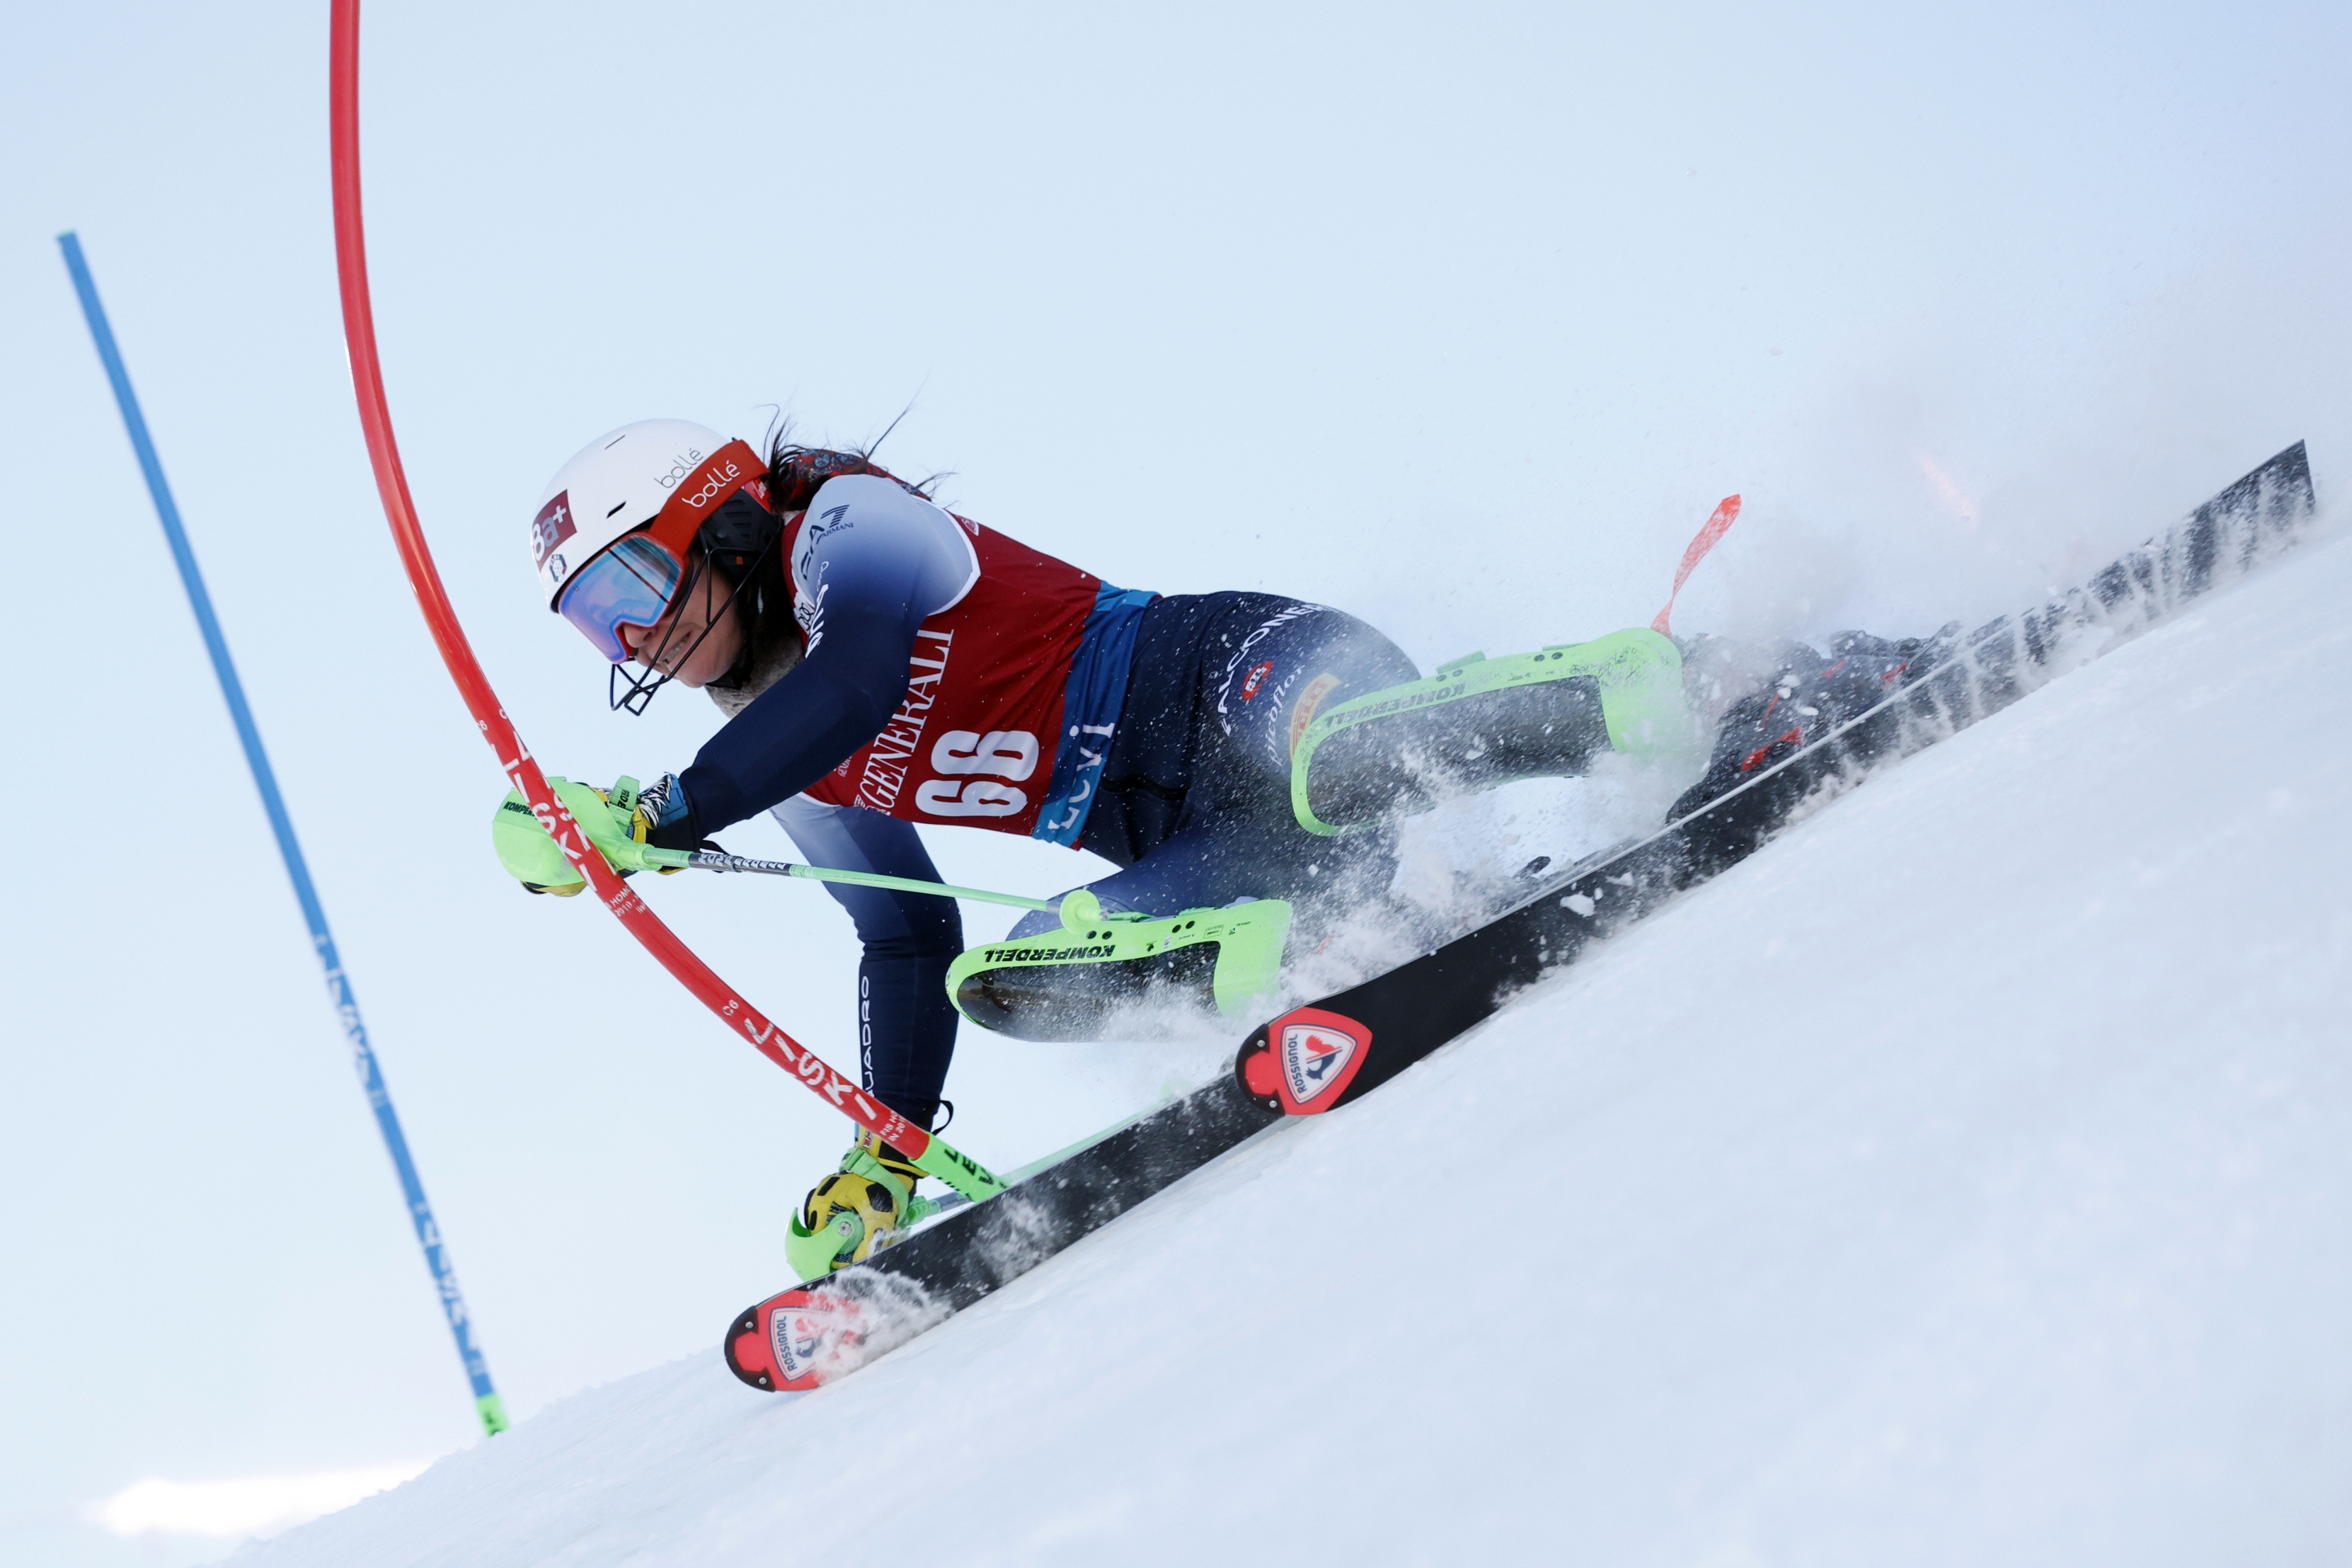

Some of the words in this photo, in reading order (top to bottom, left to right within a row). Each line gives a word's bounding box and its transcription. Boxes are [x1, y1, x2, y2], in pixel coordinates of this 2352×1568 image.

[654, 448, 704, 488] bollé
[681, 460, 740, 507] bollé
[816, 522, 854, 545] ARMANI
[859, 628, 954, 808] GENERALI
[915, 730, 1040, 817] 66
[985, 945, 1116, 963] KOMPERDELL
[722, 999, 739, 1017] C6
[744, 1018, 877, 1121] LISKI
[1288, 1034, 1307, 1094] ROSSIGNOL
[777, 1316, 797, 1372] ROSSIGNOL
